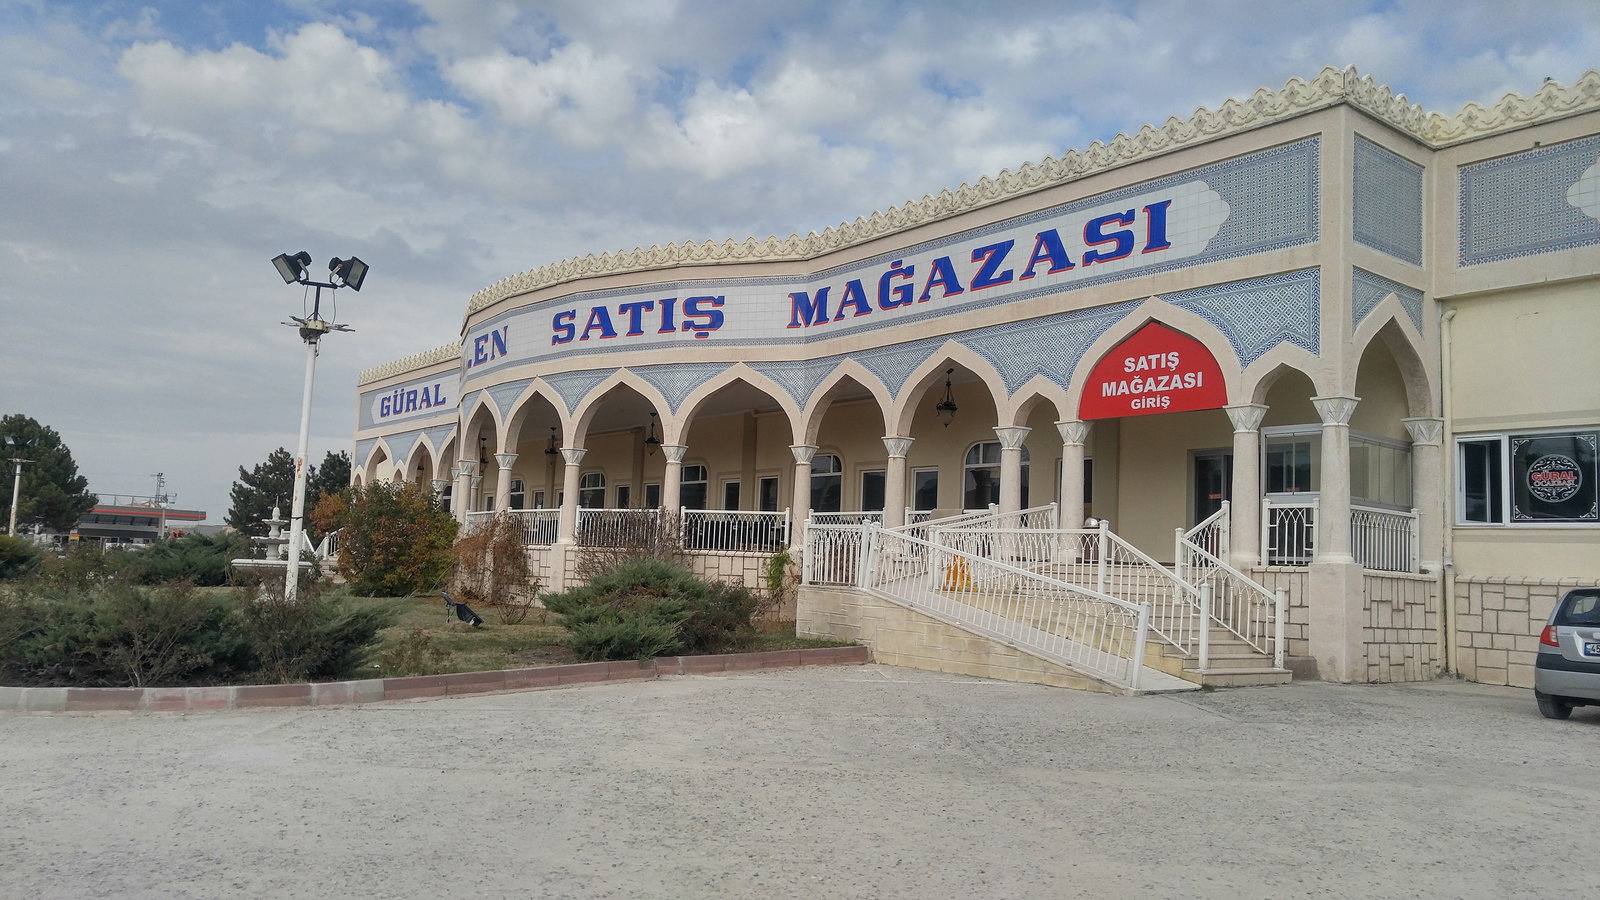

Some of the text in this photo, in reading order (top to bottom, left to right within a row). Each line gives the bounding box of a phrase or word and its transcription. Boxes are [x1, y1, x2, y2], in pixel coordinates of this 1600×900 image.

[467, 199, 1172, 369] EN SATIŞ MAĞAZASI
[1123, 351, 1180, 373] SATIŞ
[1102, 371, 1203, 397] MAĞAZASI
[380, 383, 447, 418] GÜRAL
[1130, 394, 1171, 410] GİRİŞ
[1531, 470, 1576, 481] GÜRAL
